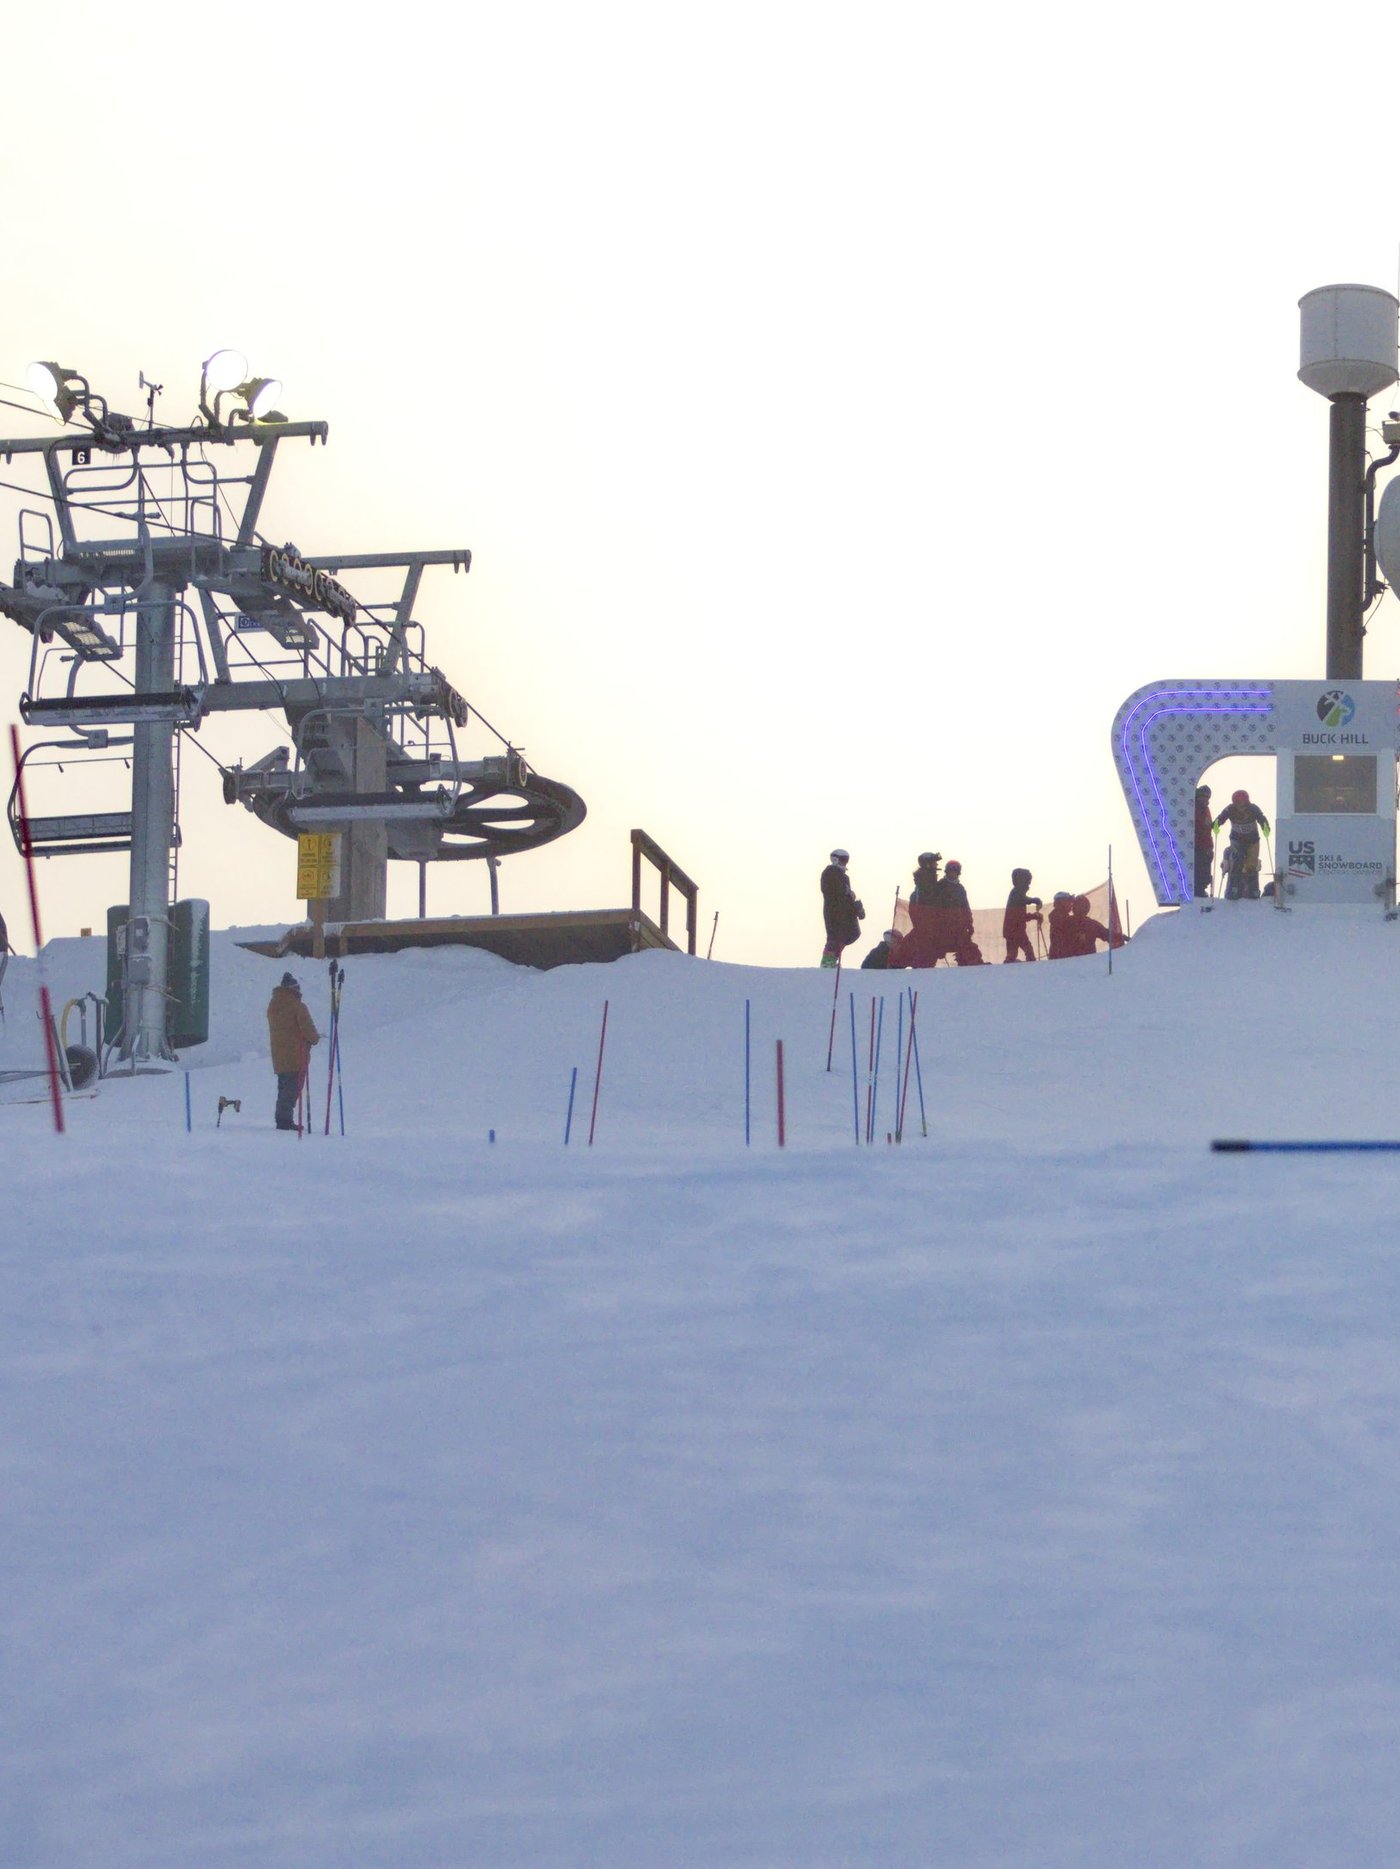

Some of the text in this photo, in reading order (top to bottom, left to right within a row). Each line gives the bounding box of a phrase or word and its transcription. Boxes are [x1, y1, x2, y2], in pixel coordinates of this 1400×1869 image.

[78, 451, 85, 464] 6
[1303, 733, 1368, 744] BUCK HILL
[1289, 841, 1315, 854] US
